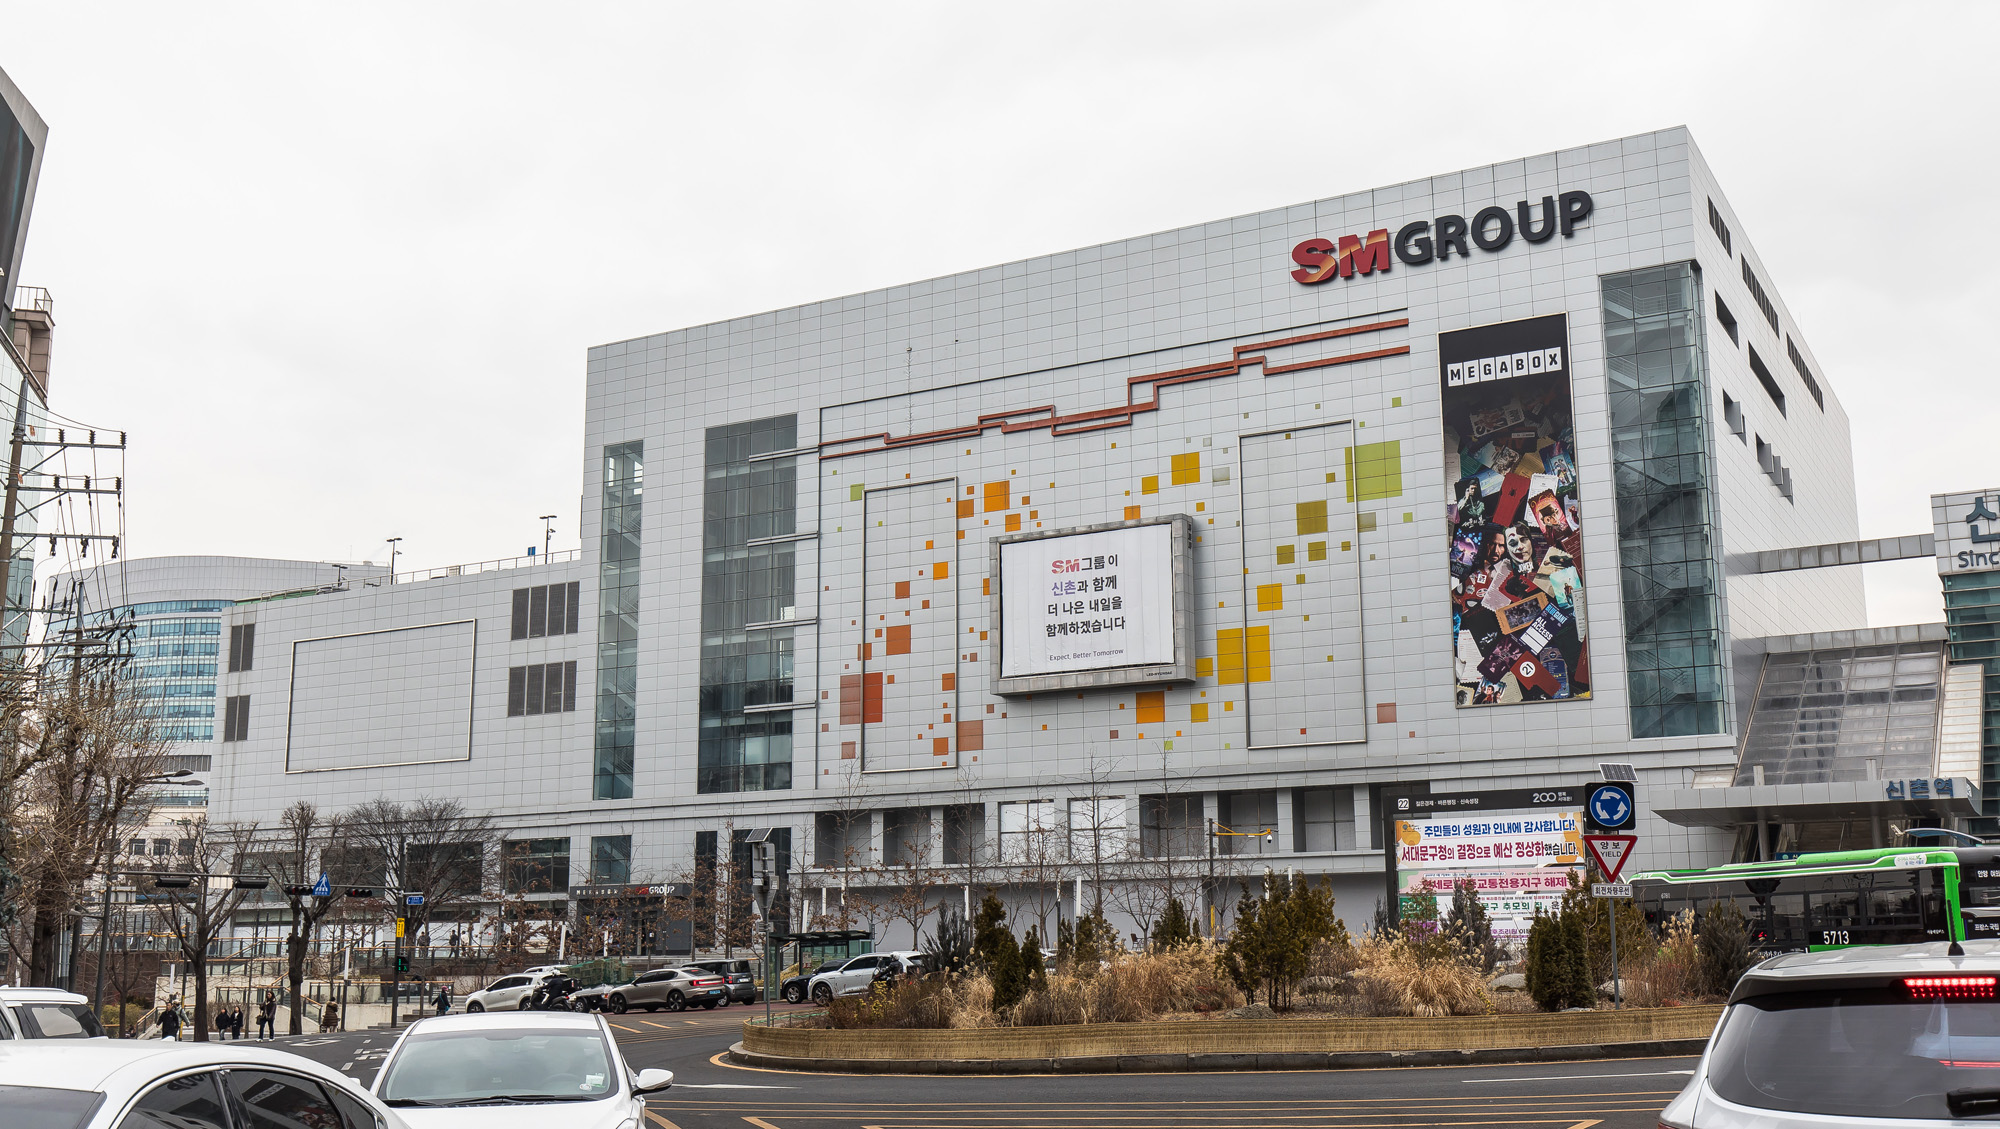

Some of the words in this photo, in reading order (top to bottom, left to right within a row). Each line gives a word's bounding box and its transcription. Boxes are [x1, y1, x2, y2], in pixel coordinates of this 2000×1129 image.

[1450, 352, 1559, 382] MEGABOX
[1051, 580, 1089, 597] 신촌과
[1092, 574, 1118, 592] 함께
[1047, 603, 1058, 617] 더
[1062, 600, 1085, 615] 나은
[1089, 596, 1123, 613] 내일을
[1046, 616, 1126, 638] 함께하겠습니다
[1531, 621, 1554, 641] ACCESS
[1536, 616, 1547, 627] ALL
[1072, 651, 1092, 660] Better
[1093, 649, 1124, 658] Tomorrow
[1886, 778, 1954, 800] 신촌역
[1398, 799, 1409, 809] 22
[1424, 824, 1460, 838] 주민들의
[1463, 823, 1491, 836] 성원과
[1493, 821, 1521, 835] 인내에
[1524, 819, 1576, 833] 감사합니다!
[1402, 844, 1455, 862] 서대문구청의
[1457, 842, 1491, 860] 결정으로
[1493, 841, 1513, 859] 예산
[1595, 886, 1630, 896] 회전차량우선
[1503, 901, 1530, 910] 추모의
[1823, 931, 1850, 945] 5713
